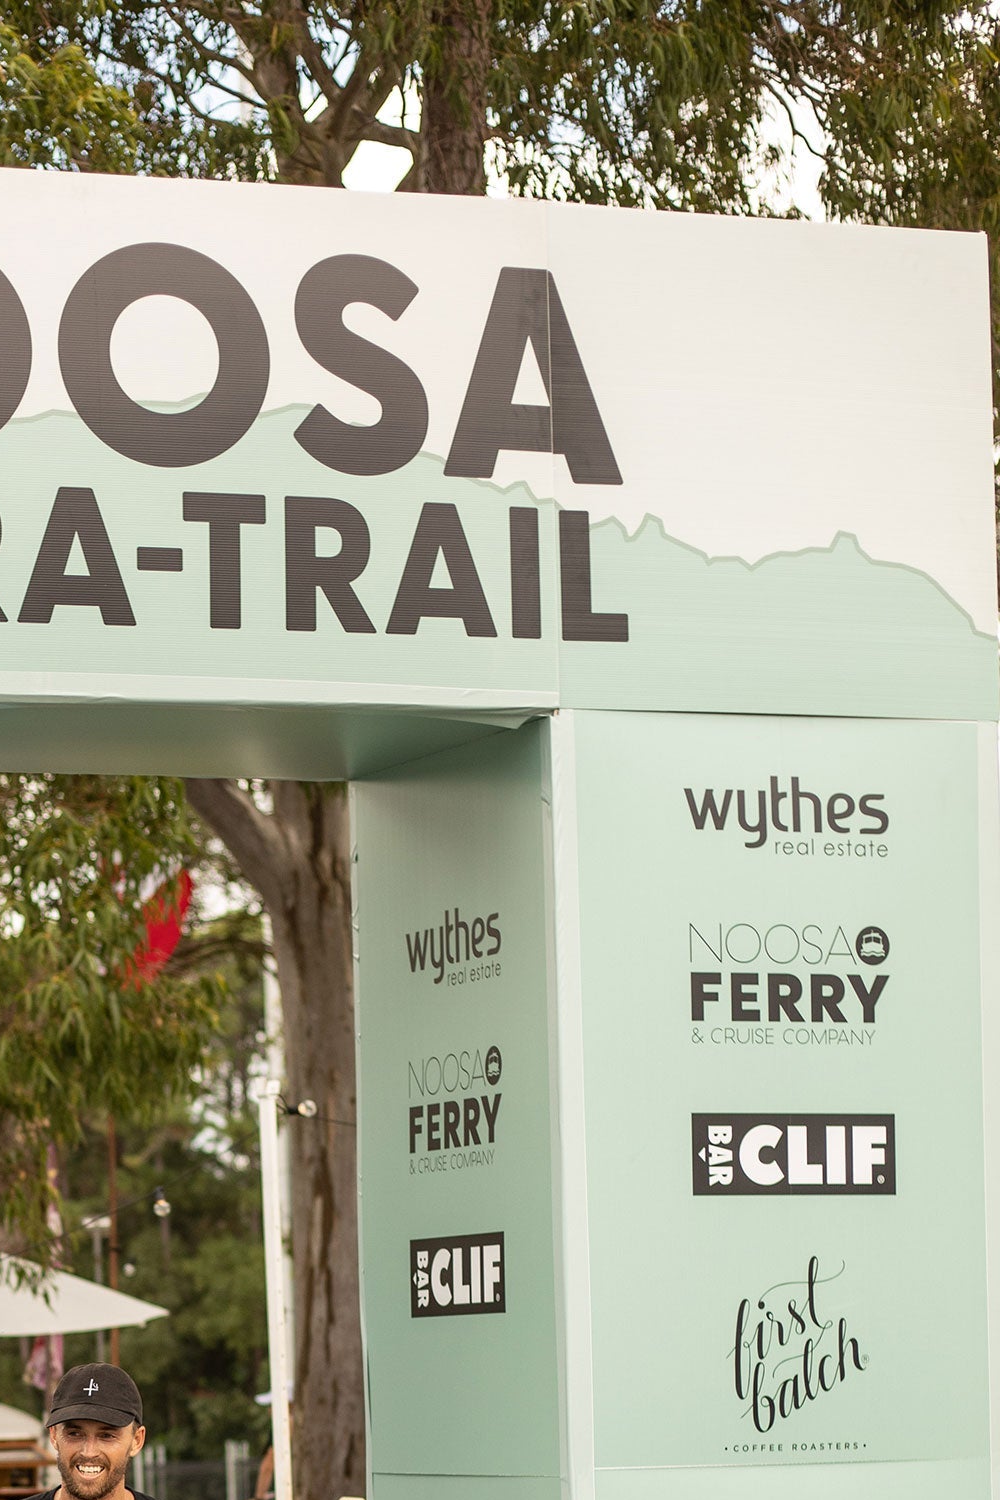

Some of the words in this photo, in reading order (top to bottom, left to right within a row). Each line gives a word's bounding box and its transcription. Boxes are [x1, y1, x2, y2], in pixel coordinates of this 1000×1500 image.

[684, 775, 889, 849] wythes
[774, 838, 815, 856] real
[823, 841, 889, 858] estate
[406, 907, 502, 984] wythes
[689, 923, 857, 966] NOOSA
[447, 966, 467, 987] real
[470, 963, 501, 983] estate
[690, 971, 890, 1023] FERRY
[691, 1028, 705, 1044] &
[710, 1028, 774, 1045] CRUISE
[782, 1028, 876, 1046] COMPANY
[408, 1049, 486, 1099] NOOSA
[409, 1093, 502, 1153] FERRY
[409, 1159, 416, 1175] &
[418, 1155, 447, 1175] CRUISE
[451, 1149, 495, 1170] COMPANY
[707, 1124, 733, 1187] BAR
[739, 1123, 887, 1187] CLIF
[417, 1250, 430, 1309] BAR
[431, 1244, 501, 1307] CLIF
[726, 1256, 845, 1400] first
[741, 1317, 866, 1433] batch
[733, 1443, 783, 1453] COFFEE
[792, 1442, 859, 1451] ROASTERS
